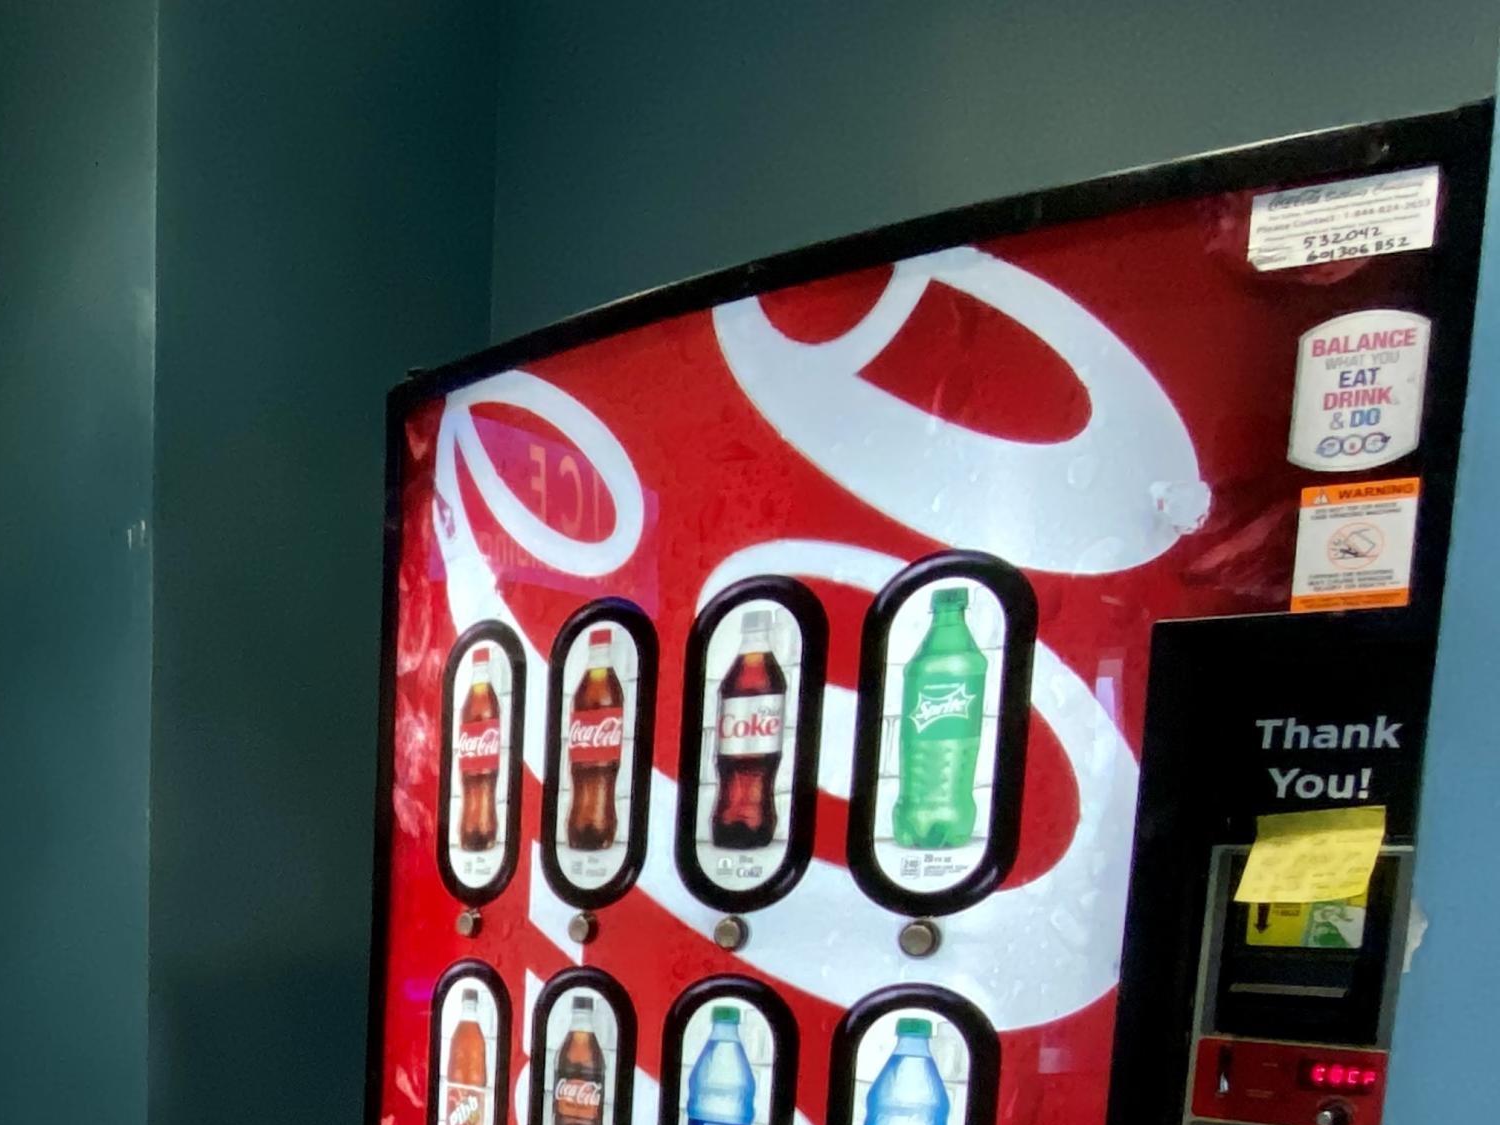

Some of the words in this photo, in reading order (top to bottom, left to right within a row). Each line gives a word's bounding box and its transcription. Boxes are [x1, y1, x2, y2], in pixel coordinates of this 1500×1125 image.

[1311, 327, 1417, 357] BALANCE
[1325, 353, 1364, 370] WHAT
[1371, 350, 1400, 366] YOU
[1338, 367, 1381, 388] EAT
[1323, 386, 1393, 411] DRINK
[1329, 411, 1344, 430] &
[1350, 407, 1381, 428] DO
[1338, 482, 1415, 500] WARNING
[916, 695, 968, 720] Sprite
[718, 712, 781, 739] Coke
[1255, 715, 1403, 750] Thank
[1267, 767, 1373, 799] You!
